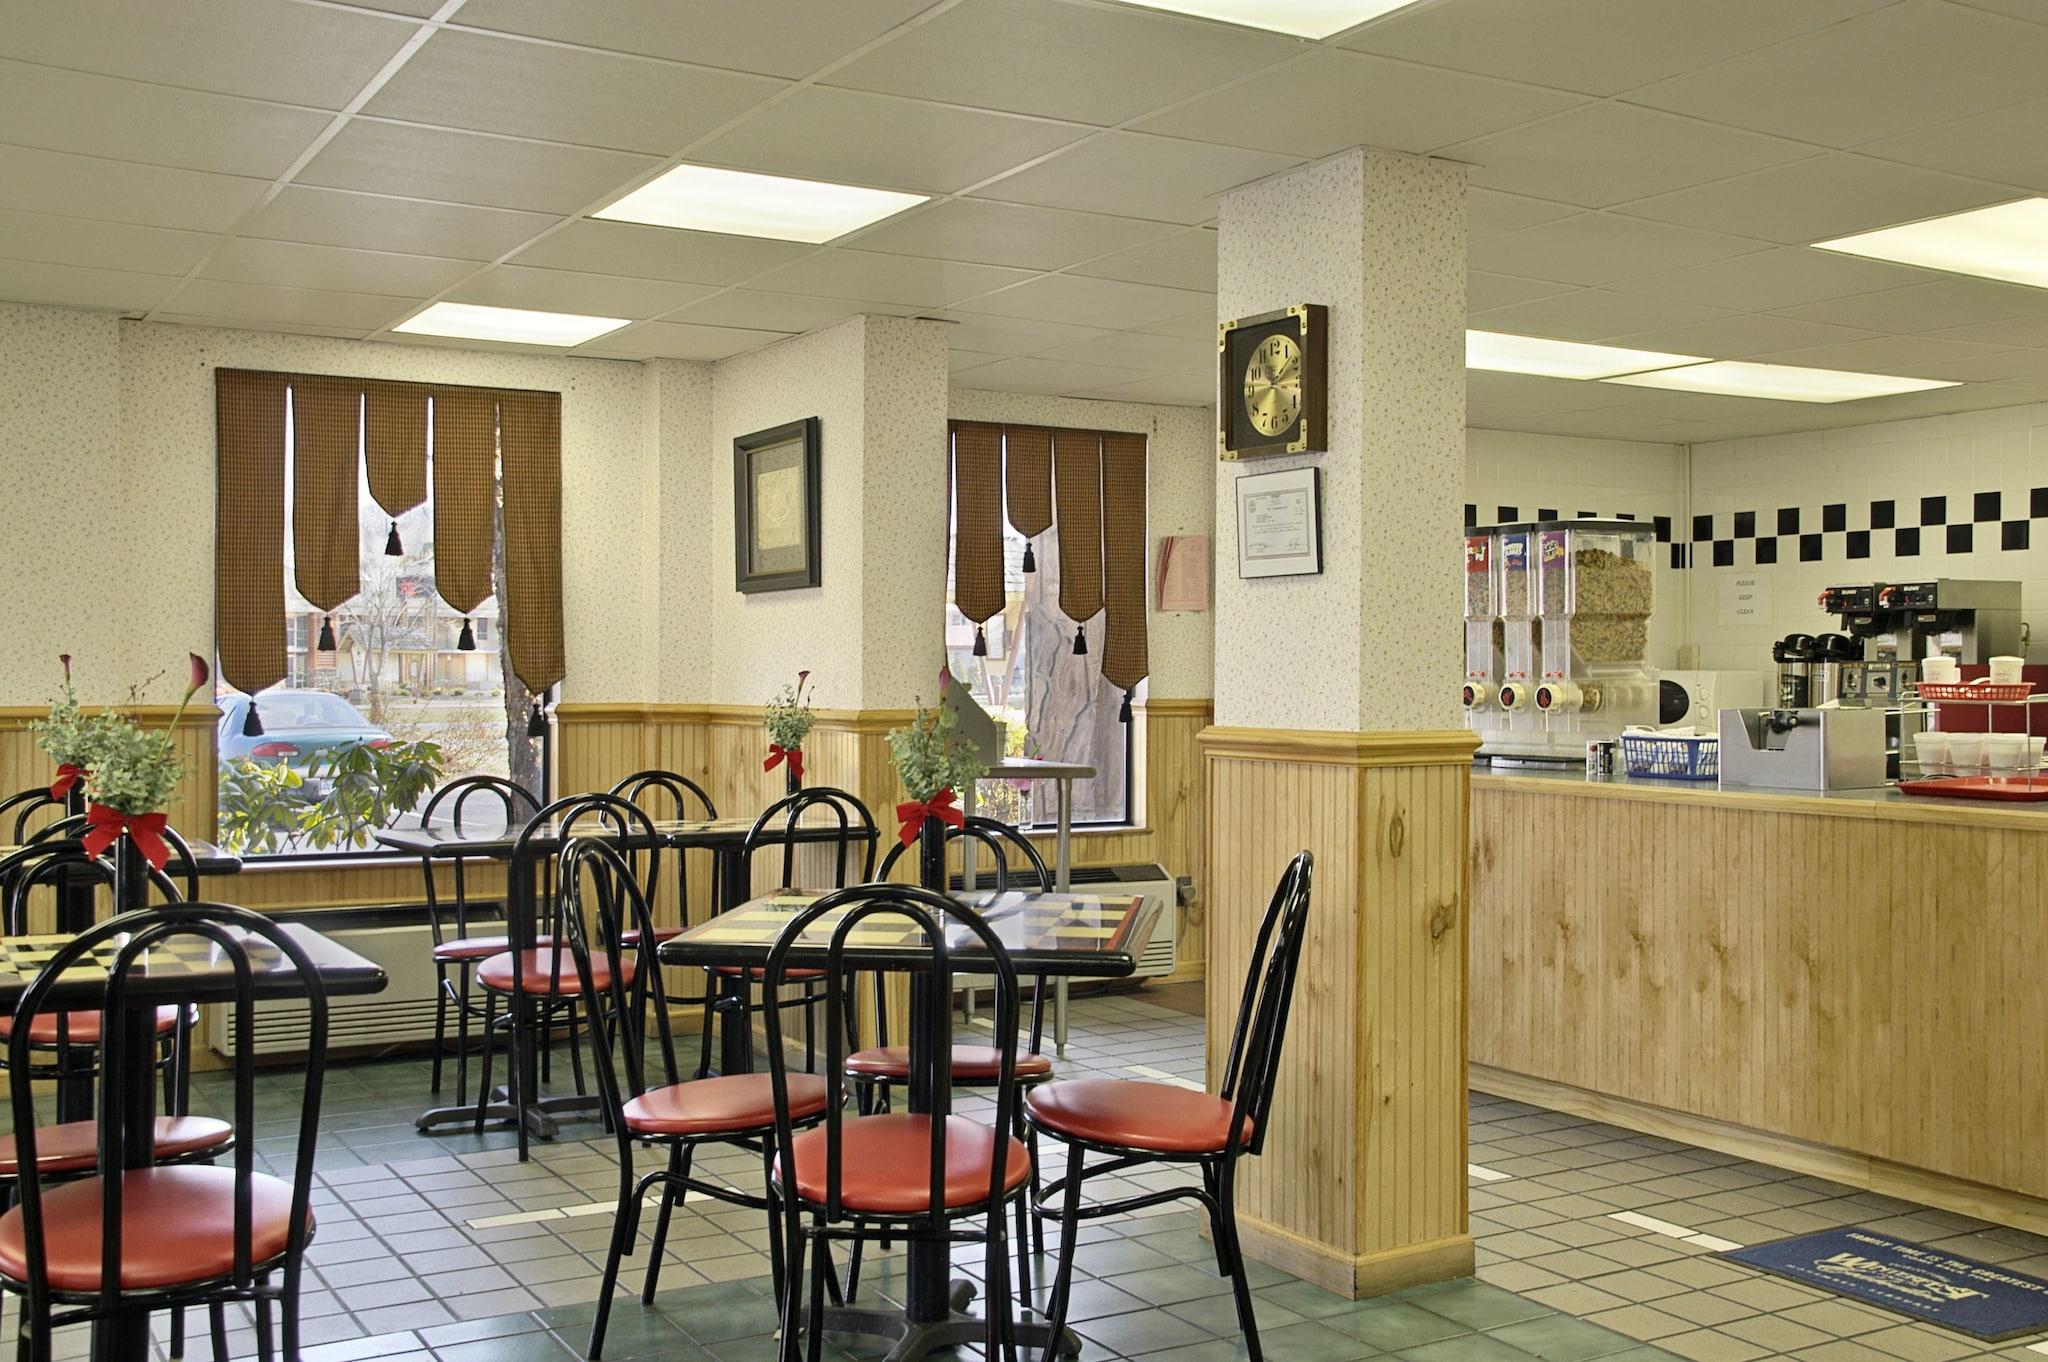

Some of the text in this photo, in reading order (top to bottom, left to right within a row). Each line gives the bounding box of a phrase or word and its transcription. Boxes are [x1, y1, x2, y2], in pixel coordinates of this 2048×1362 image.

[1270, 340, 1280, 356] 12
[1284, 344, 1288, 359] 1
[1259, 349, 1267, 364] 11
[1292, 356, 1299, 371] 2
[1251, 367, 1261, 382] 10
[1248, 385, 1254, 398] 9
[1252, 403, 1259, 416] 8
[1282, 409, 1289, 424] 5
[1262, 412, 1268, 427] 7
[1271, 416, 1278, 430] 6
[1735, 579, 1756, 587] PLEASE
[1845, 1232, 1894, 1247] FAMILY
[1891, 1245, 1928, 1257] TIME
[1943, 1260, 1973, 1270] THE
[1970, 1268, 2046, 1291] GREATEST
